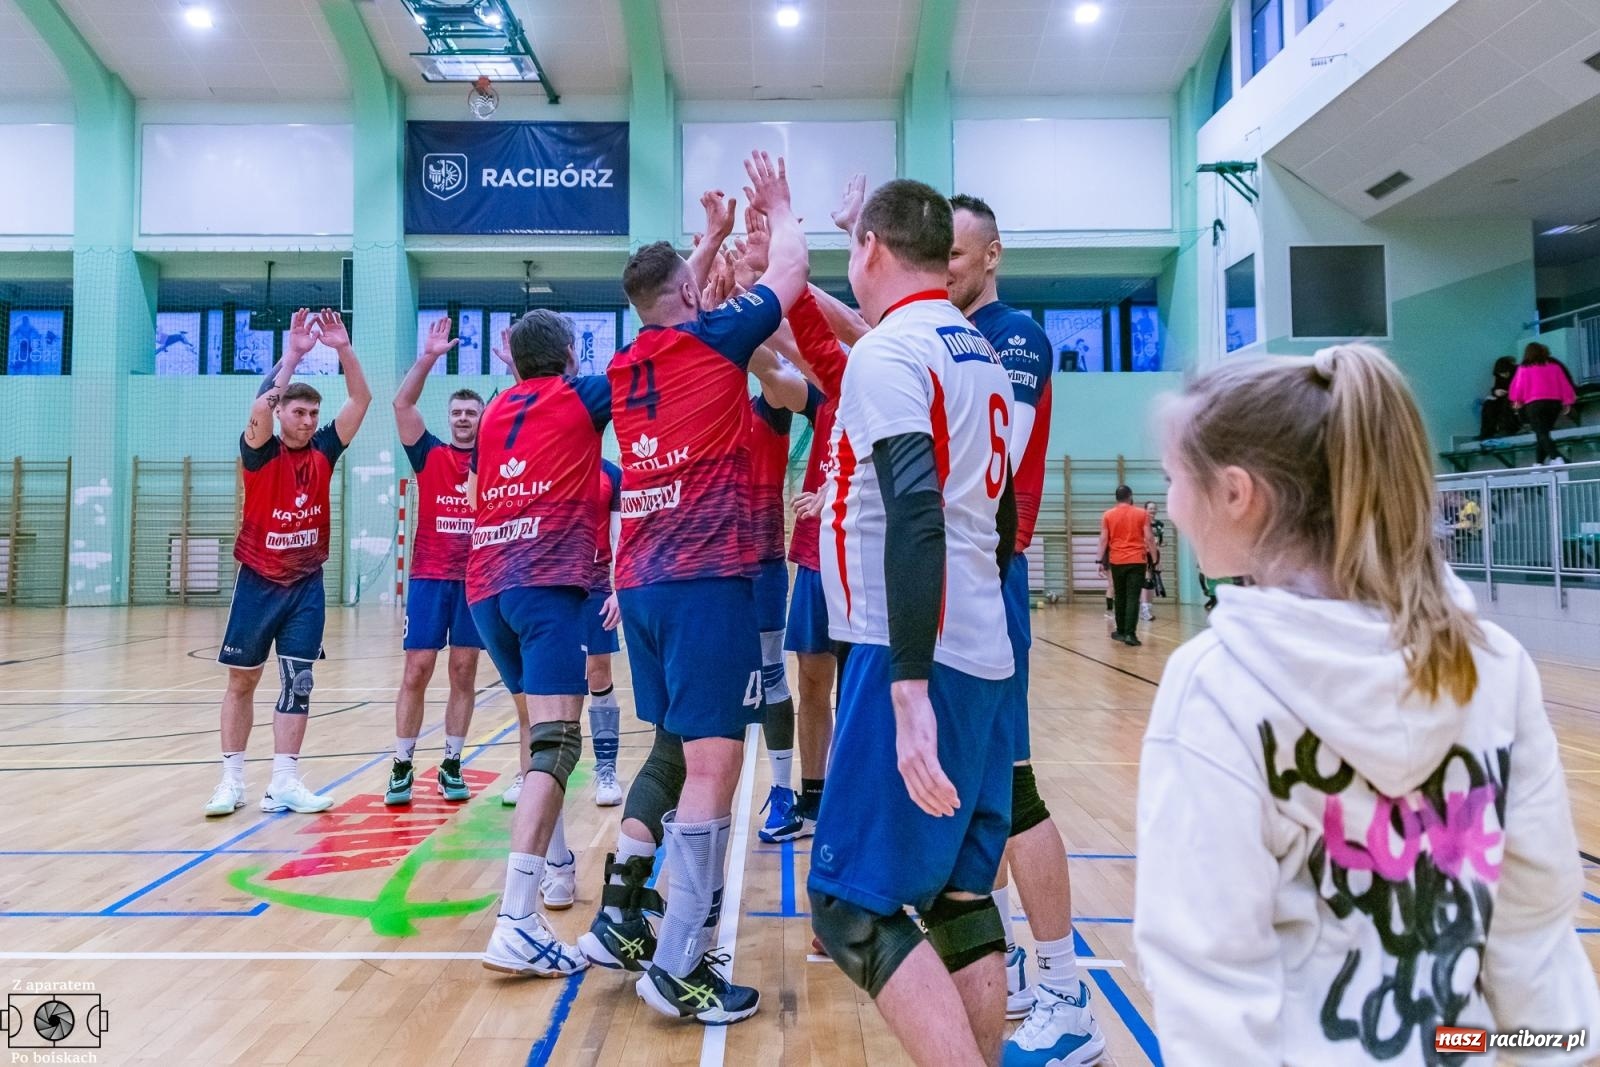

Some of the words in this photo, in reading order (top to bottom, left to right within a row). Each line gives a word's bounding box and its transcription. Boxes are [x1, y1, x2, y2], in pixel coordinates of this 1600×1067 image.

[481, 162, 614, 188] RACIBÓRZ
[625, 358, 662, 421] 4
[504, 391, 540, 450] 7
[985, 392, 1009, 500] 6
[436, 494, 470, 506] KATO
[743, 670, 763, 710] 4
